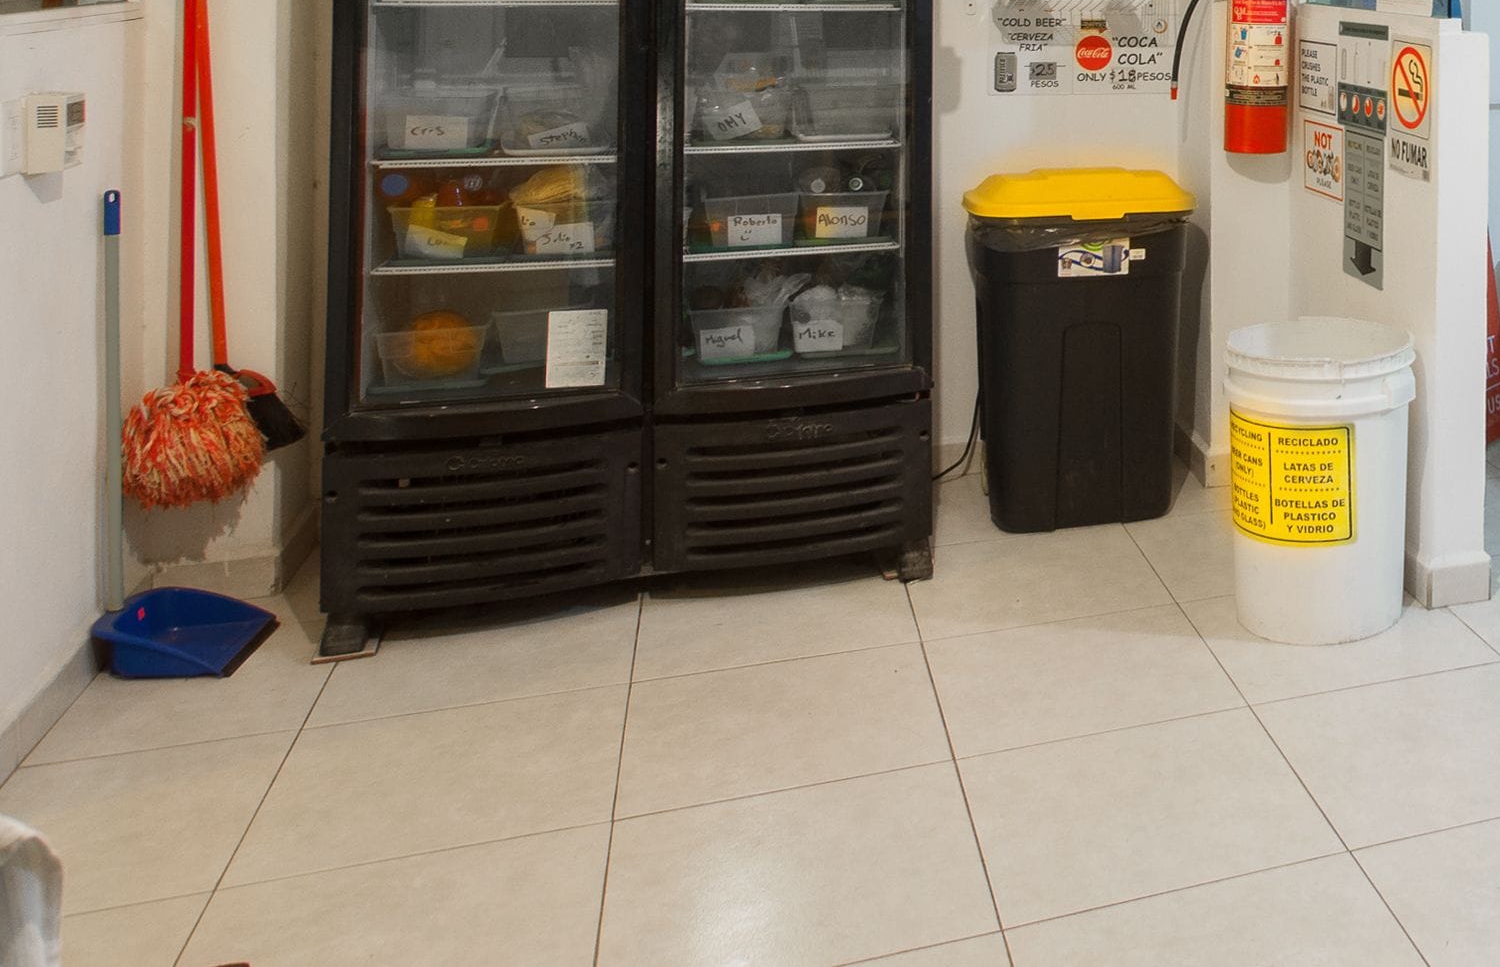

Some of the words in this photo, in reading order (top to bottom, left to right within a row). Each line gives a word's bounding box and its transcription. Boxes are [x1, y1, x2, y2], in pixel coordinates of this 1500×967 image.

[1301, 48, 1318, 59] PLEASE
[1076, 73, 1107, 82] ONLY
[1136, 72, 1172, 81] PESOS
[1301, 73, 1310, 83] THE
[1310, 75, 1329, 87] PLASTIC
[1313, 130, 1333, 150] NOT
[1391, 137, 1402, 160] NO
[1402, 141, 1428, 169] FUMAR
[733, 216, 779, 227] Roberto
[818, 214, 867, 226] Alonso
[1278, 437, 1339, 447] RECICLADO
[1243, 453, 1263, 467] CANS
[1283, 463, 1316, 471] LATAS
[1319, 463, 1334, 471] DE
[1284, 475, 1334, 484] CERVEZA
[1274, 499, 1329, 509] BOTELLAS
[1332, 498, 1345, 507] DE
[1283, 512, 1336, 521] PLASTICO
[1286, 525, 1293, 533] Y
[1297, 524, 1334, 534] VIDRIO
